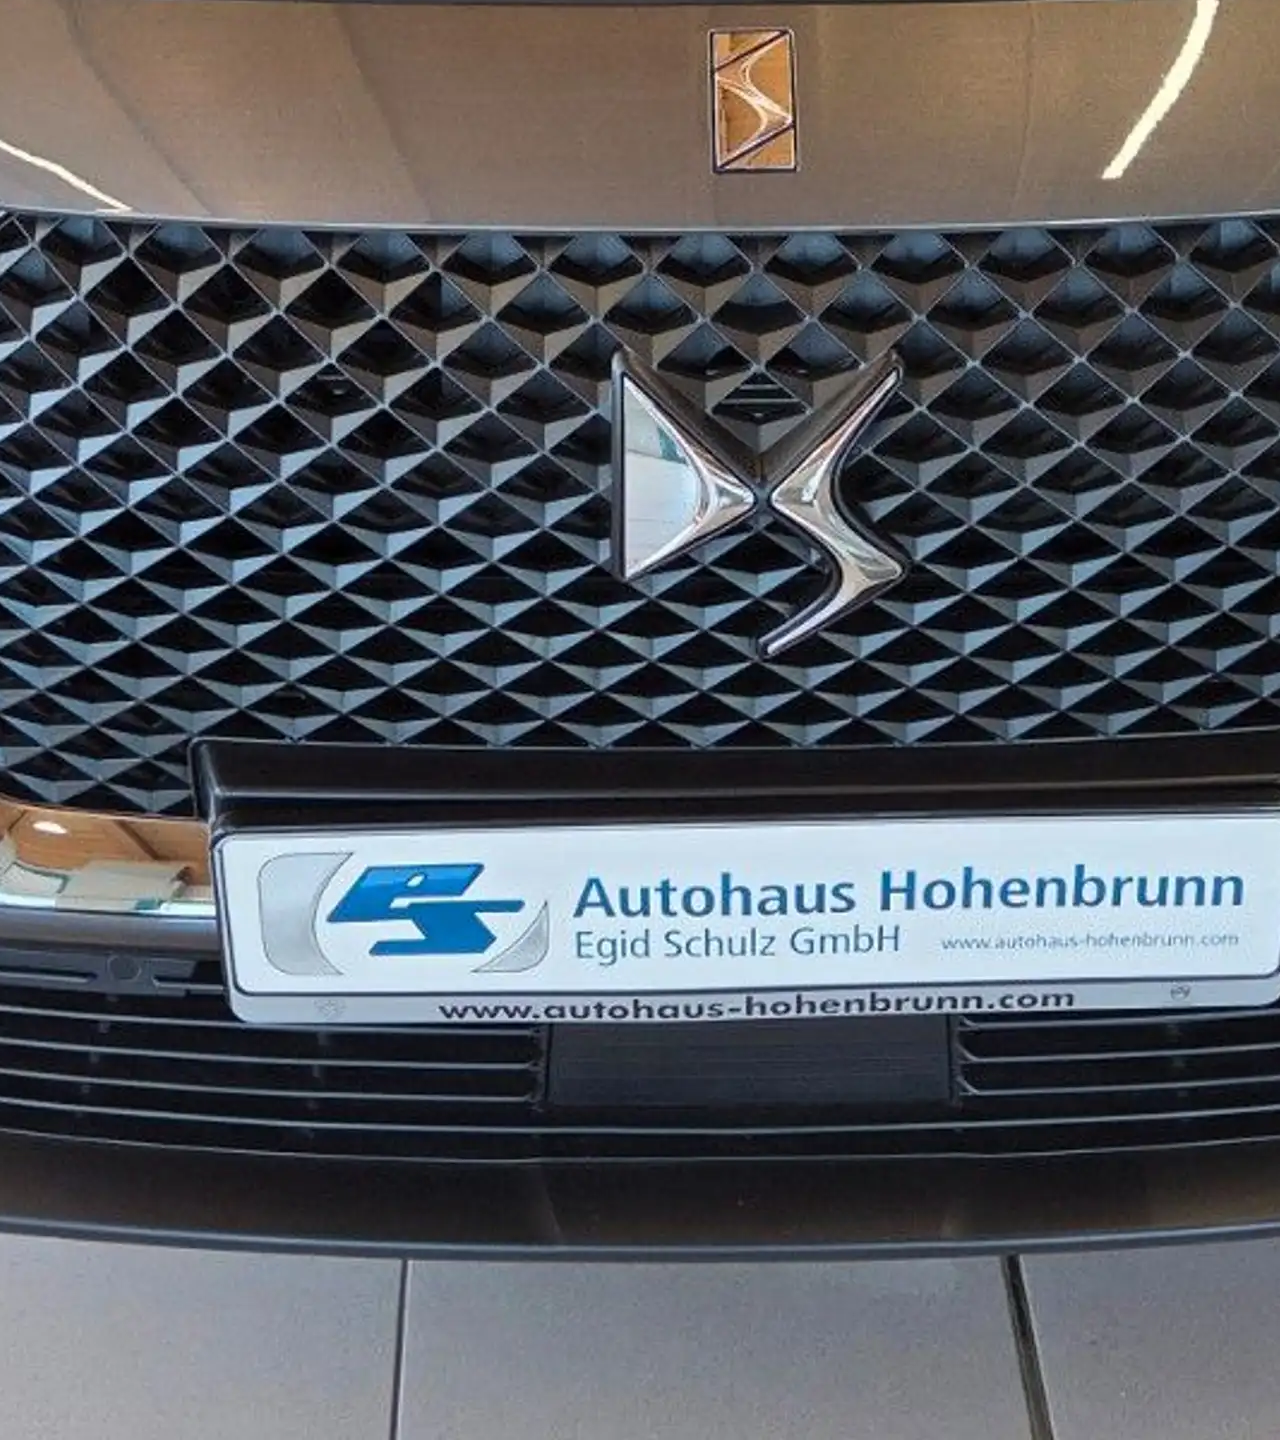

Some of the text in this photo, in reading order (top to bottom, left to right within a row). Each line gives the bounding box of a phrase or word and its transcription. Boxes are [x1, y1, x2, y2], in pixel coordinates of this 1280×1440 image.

[573, 864, 1244, 918] Autohaus Hohenbrunn
[575, 923, 901, 967] Egid Schulz GmbH
[941, 933, 1240, 951] www.autohaus-hohenbrunn.com
[438, 990, 1075, 1020] www.autohaus-hohenbrunn.com
